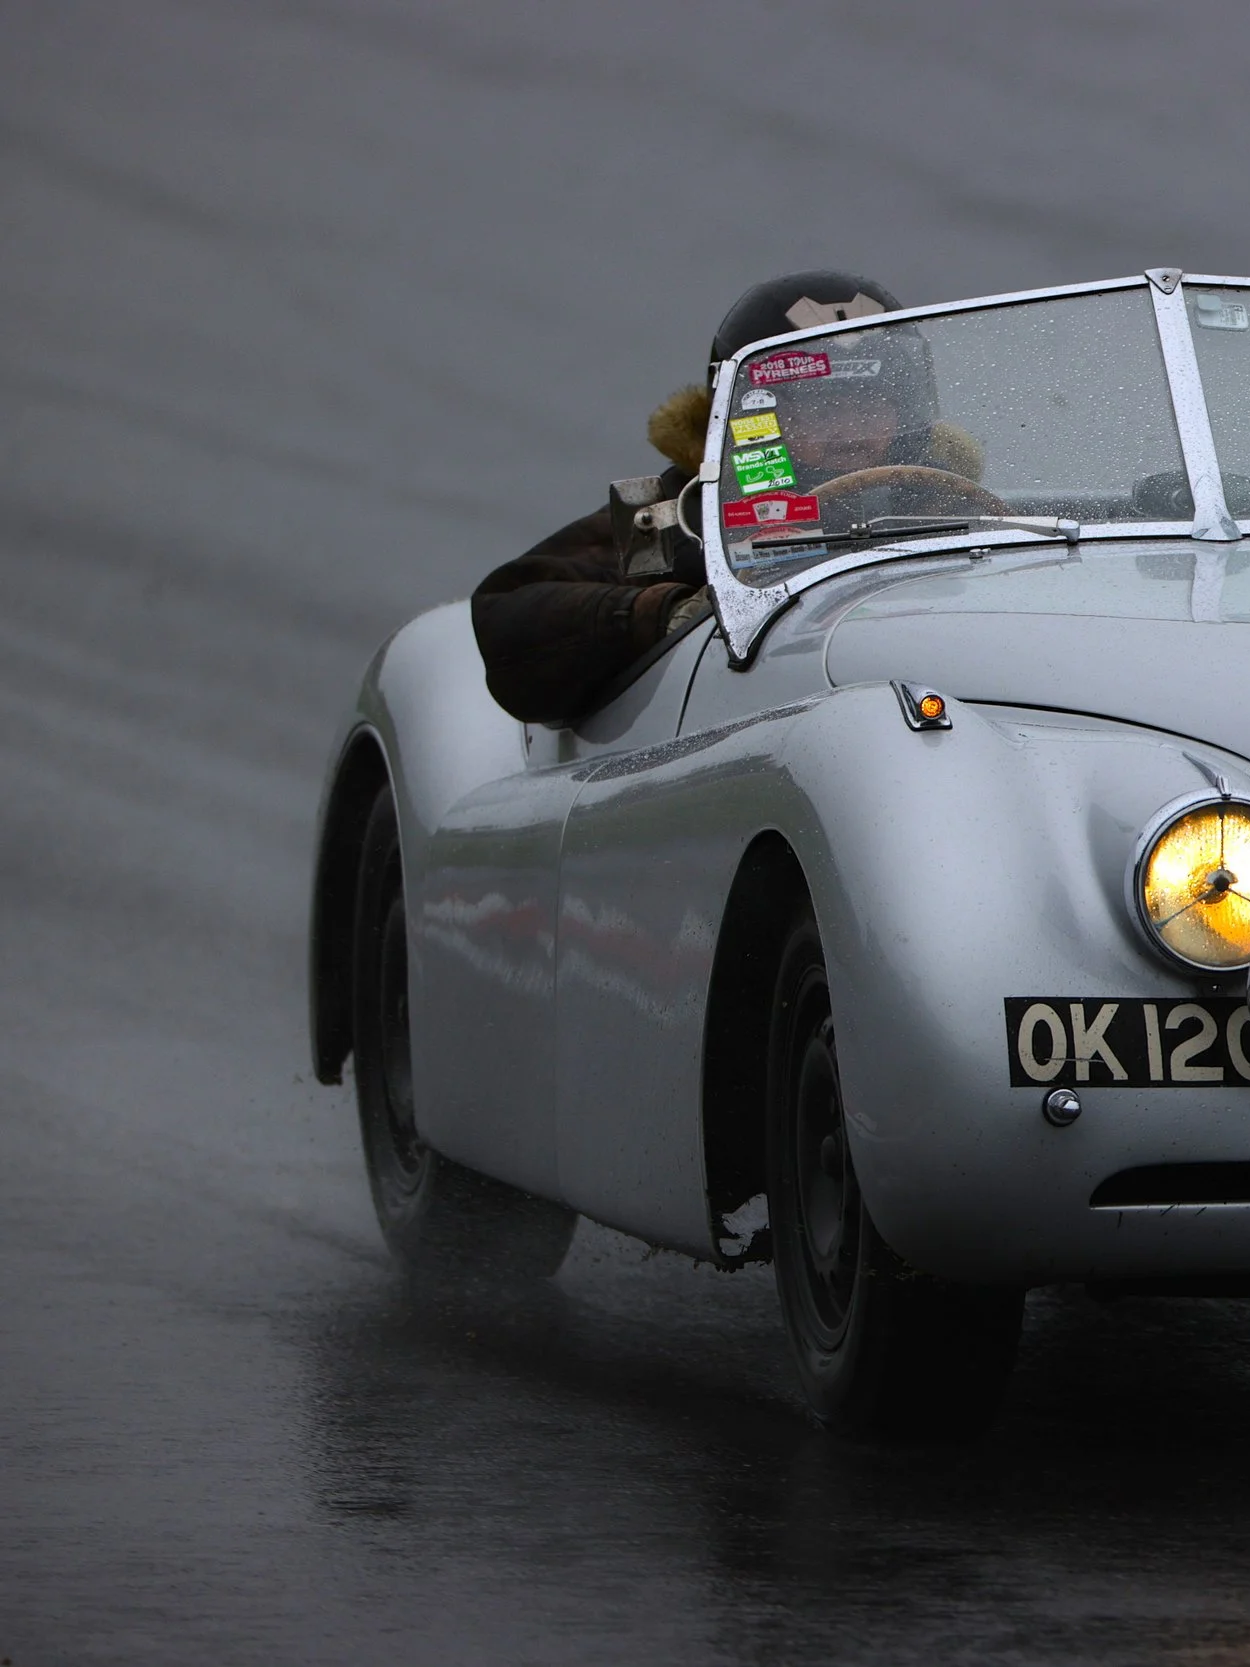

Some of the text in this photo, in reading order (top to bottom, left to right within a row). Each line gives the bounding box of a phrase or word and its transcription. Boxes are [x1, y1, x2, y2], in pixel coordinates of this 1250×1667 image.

[753, 360, 826, 380] PYRENEES
[737, 460, 764, 471] Brands
[1018, 1003, 1129, 1082] OK
